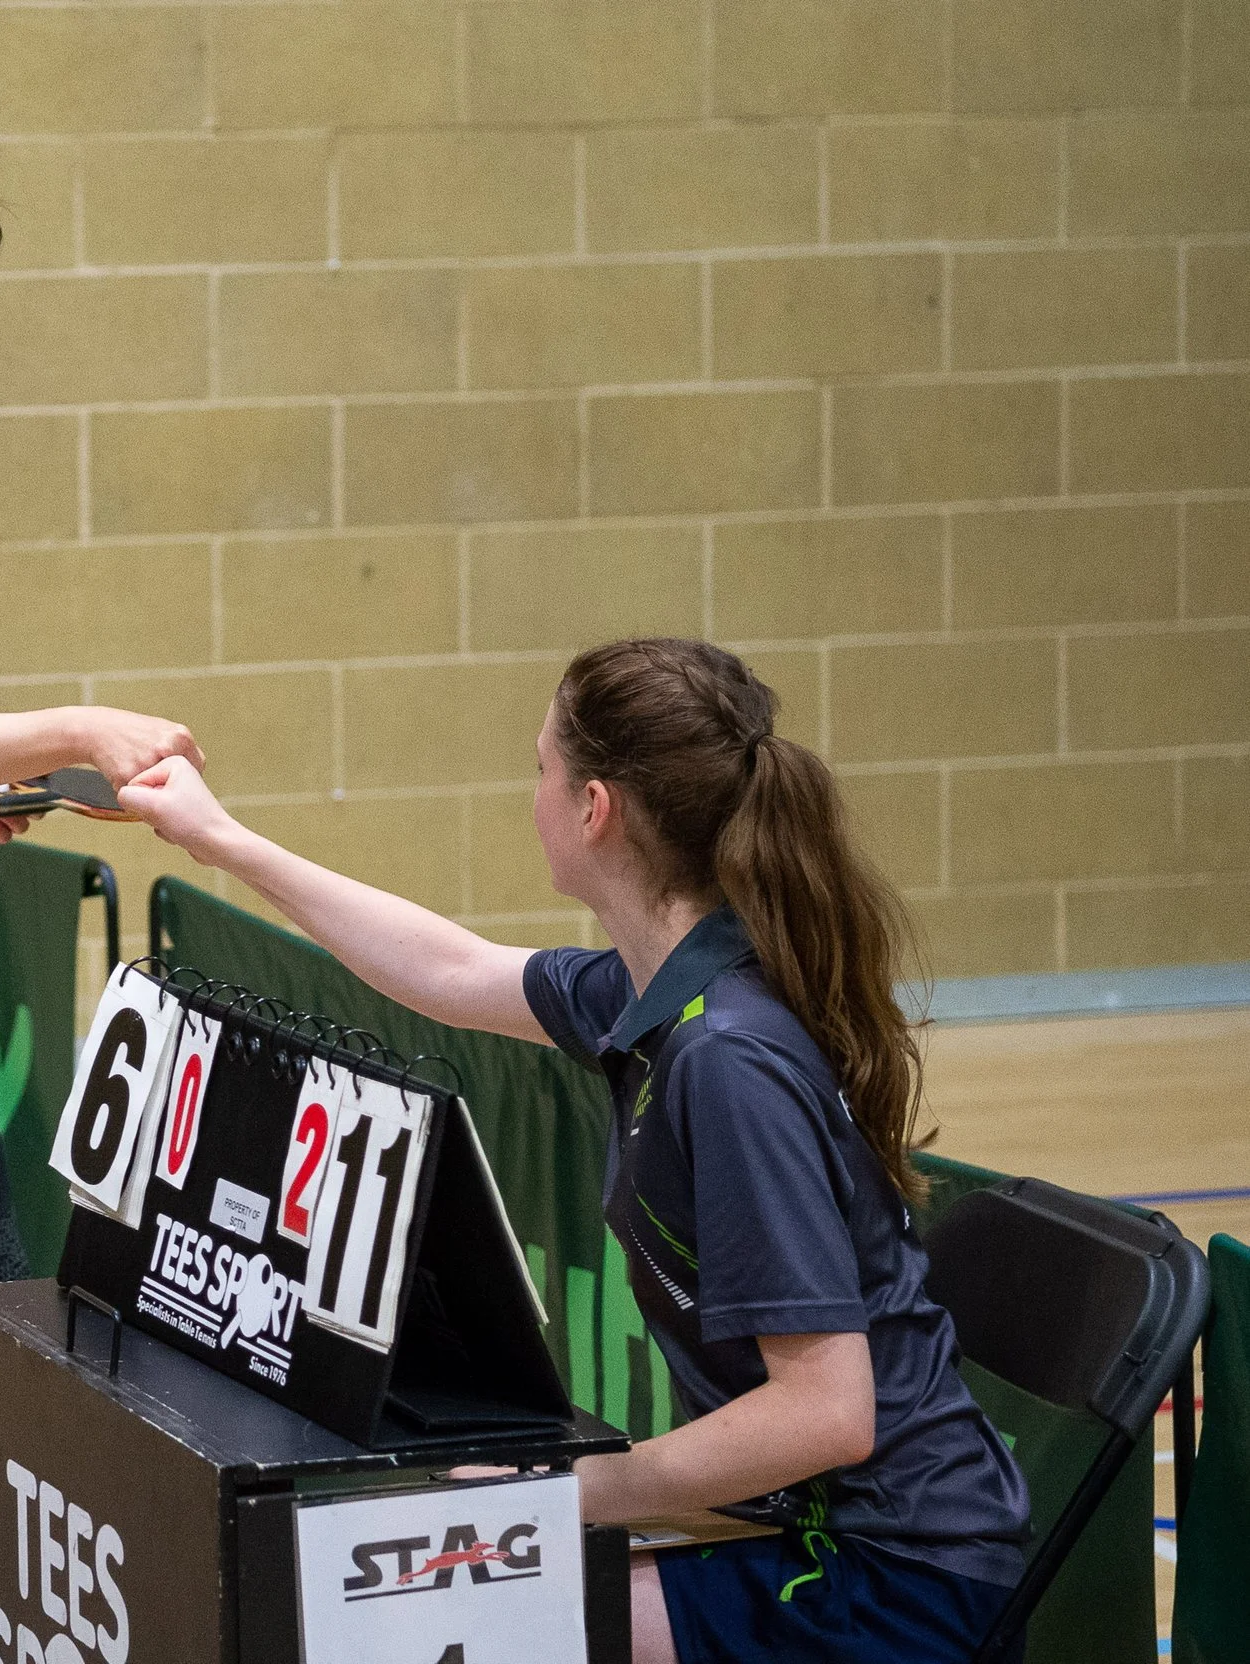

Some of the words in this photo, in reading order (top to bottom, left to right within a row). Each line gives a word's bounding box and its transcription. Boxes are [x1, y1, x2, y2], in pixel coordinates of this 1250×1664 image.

[71, 1007, 147, 1185] 6
[167, 1053, 202, 1175] 0
[224, 1198, 253, 1217] PROPERTY
[252, 1210, 261, 1220] OF
[283, 1103, 328, 1237] 2
[318, 1114, 411, 1330] 11
[136, 1295, 171, 1323] Specialists
[170, 1312, 178, 1327] in
[177, 1316, 195, 1337] Table
[195, 1325, 217, 1348] Tennis
[150, 1213, 213, 1295] TEES
[207, 1245, 305, 1344] SPORT
[249, 1356, 269, 1376] Since
[269, 1366, 287, 1386] 1976
[6, 1459, 129, 1664] TEES
[344, 1523, 542, 1598] STAG
